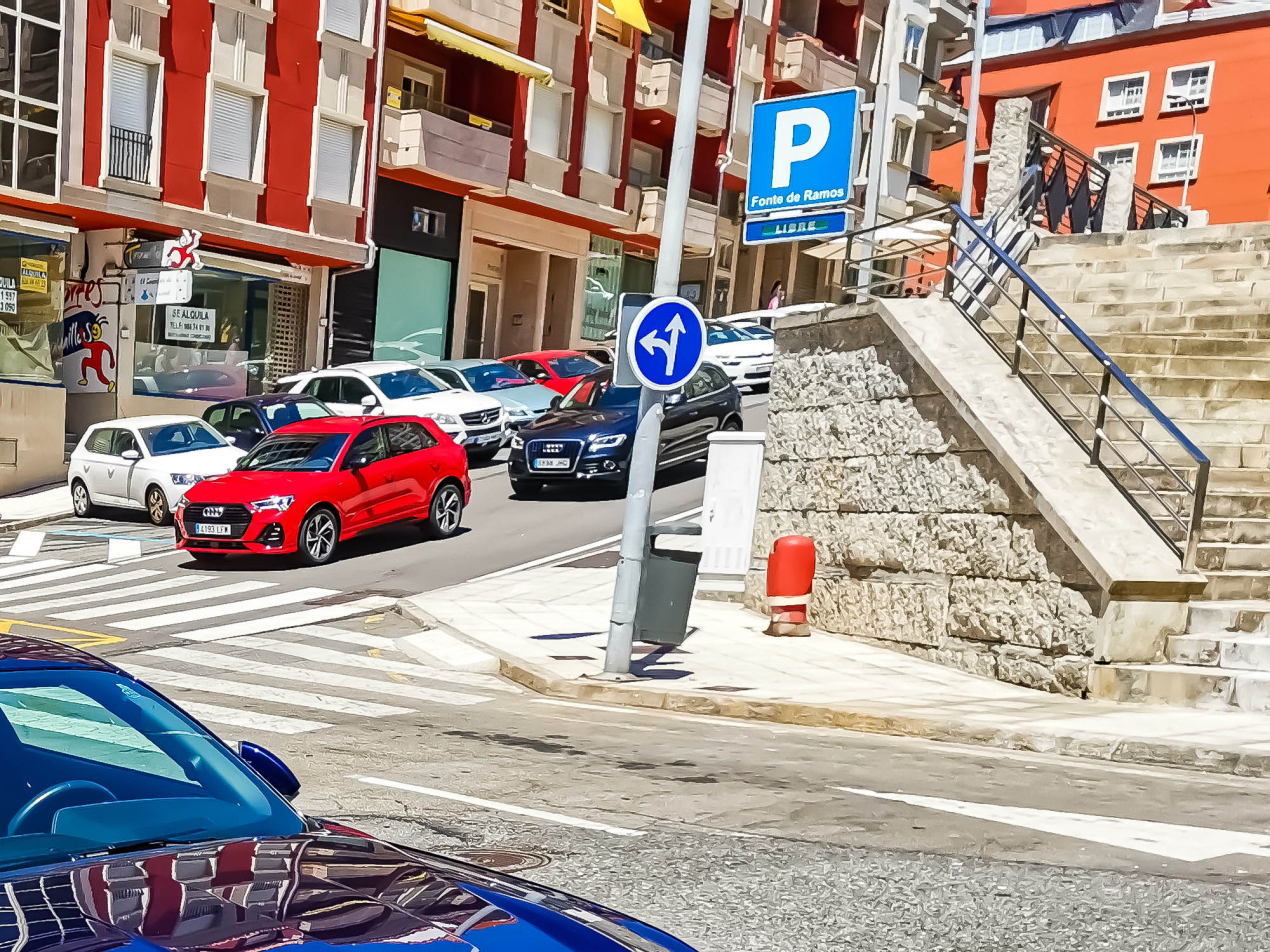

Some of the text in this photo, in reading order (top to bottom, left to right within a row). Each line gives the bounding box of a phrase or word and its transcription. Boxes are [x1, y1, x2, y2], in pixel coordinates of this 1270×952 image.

[772, 107, 830, 188] P
[751, 188, 844, 207] Fonte de Ramos
[775, 220, 816, 234] LIBRE
[172, 309, 209, 320] SE ALQUILA
